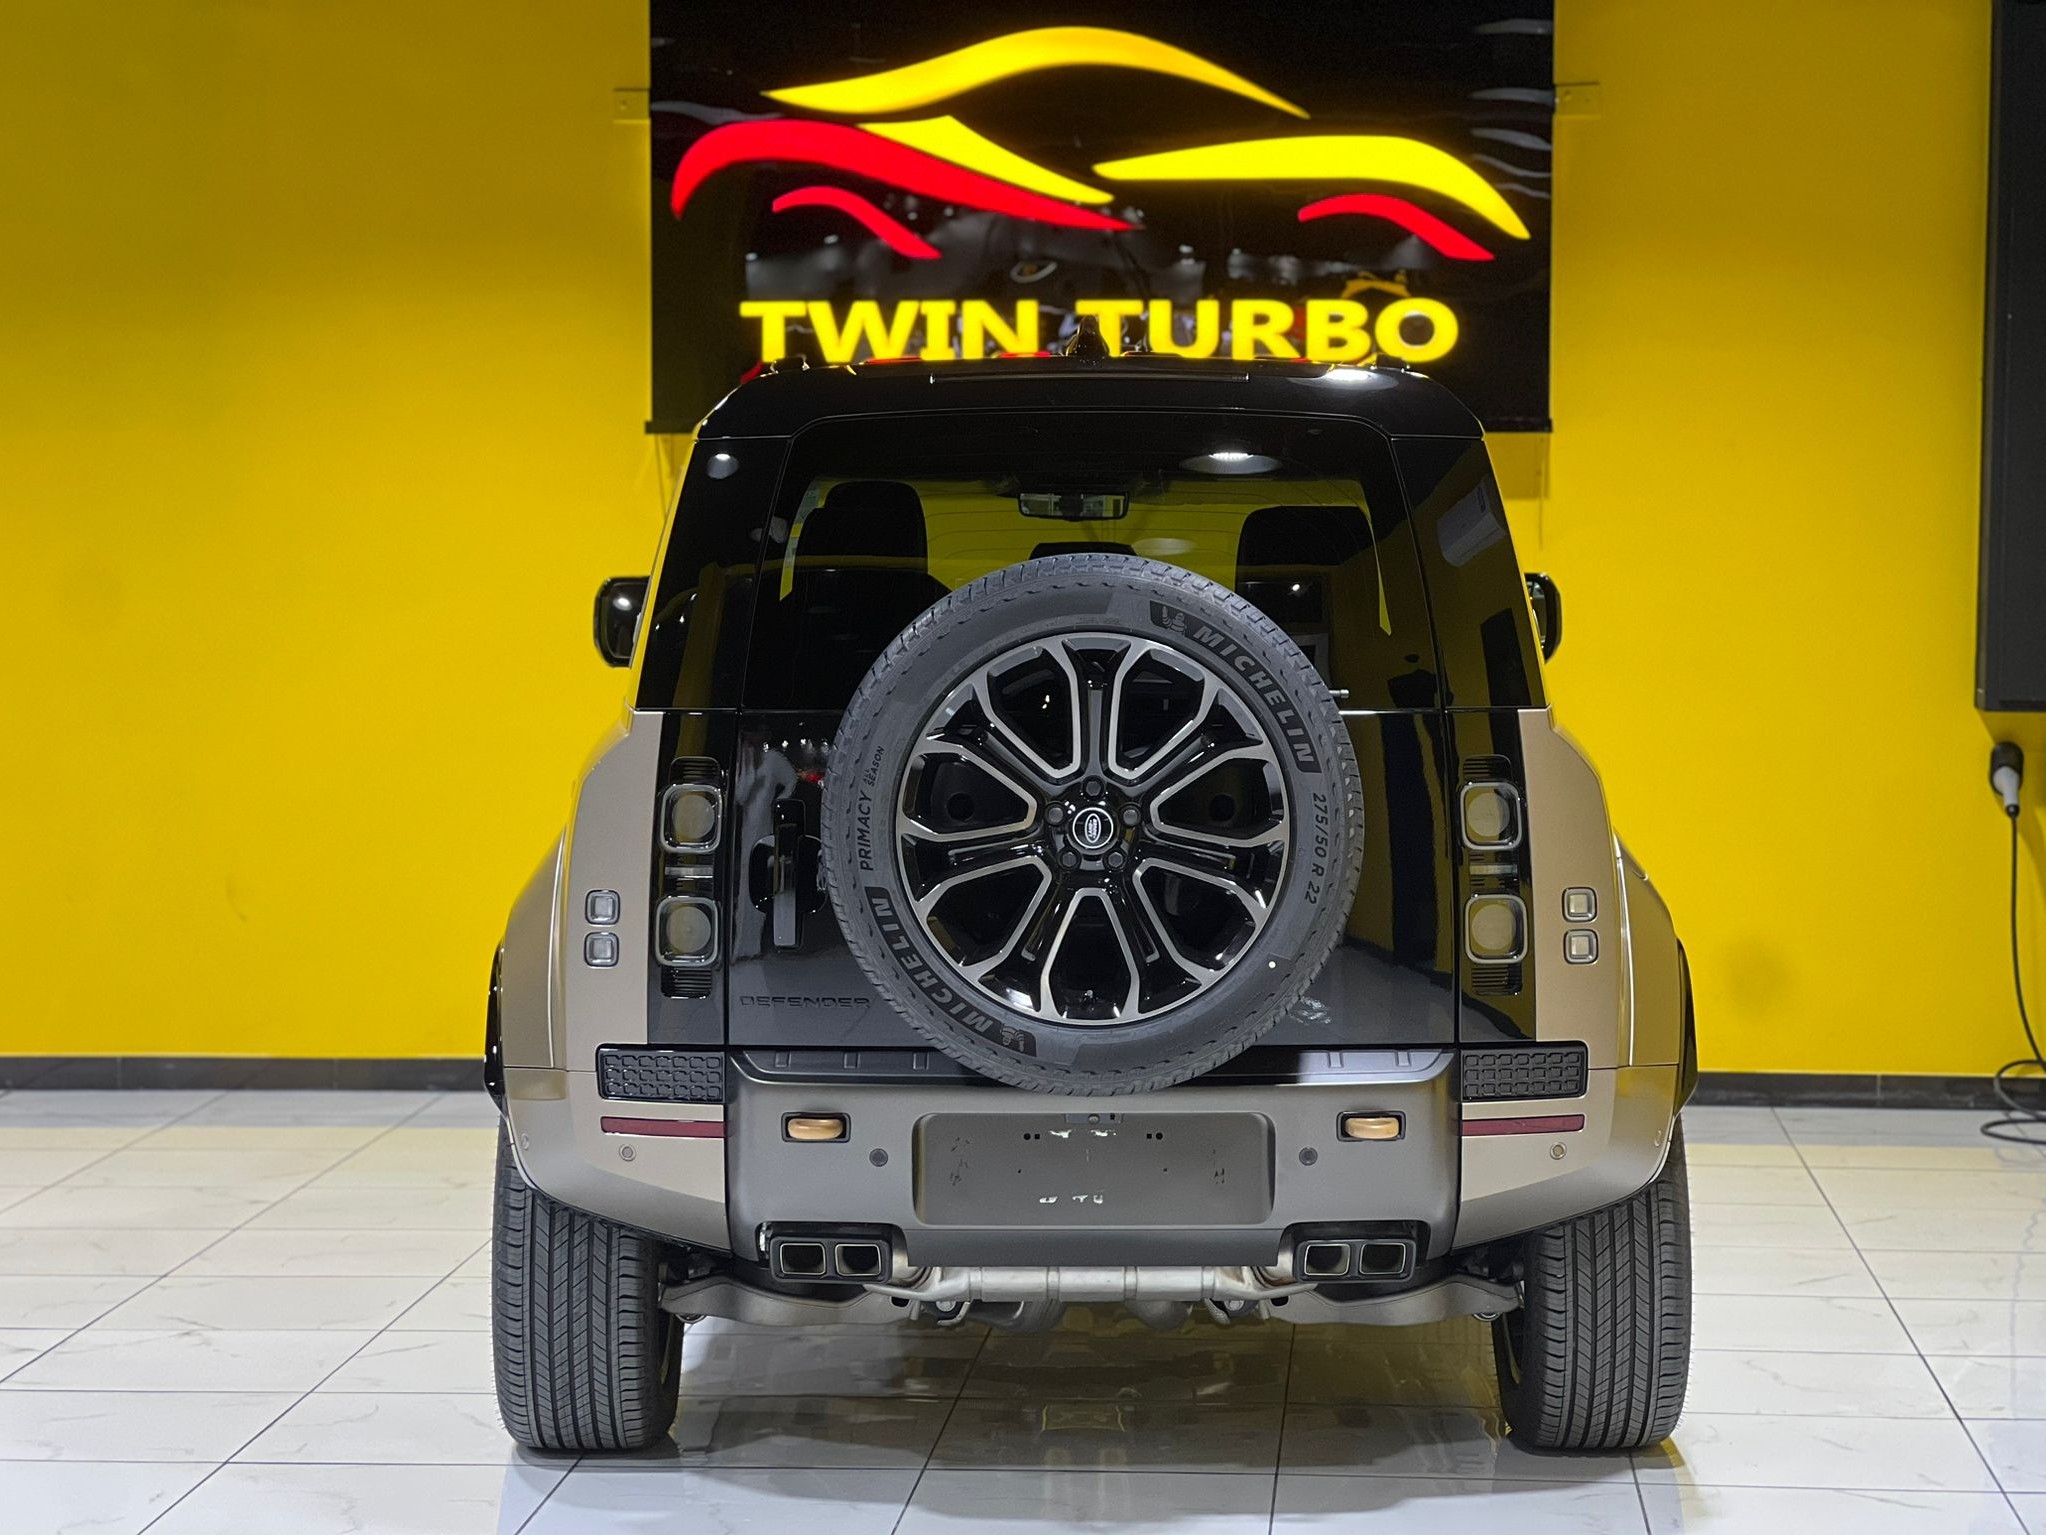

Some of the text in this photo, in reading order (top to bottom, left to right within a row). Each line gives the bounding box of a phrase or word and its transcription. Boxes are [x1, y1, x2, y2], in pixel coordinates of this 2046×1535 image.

[740, 298, 1459, 363] TWIN TURBO
[1193, 625, 1315, 762] MICHELIN
[867, 745, 885, 787] SEASON
[857, 790, 874, 871] PRIMACY
[1304, 793, 1329, 904] 275/50 R 22
[739, 995, 871, 1008] DEFENDER
[872, 897, 994, 1033] MICHELIN
